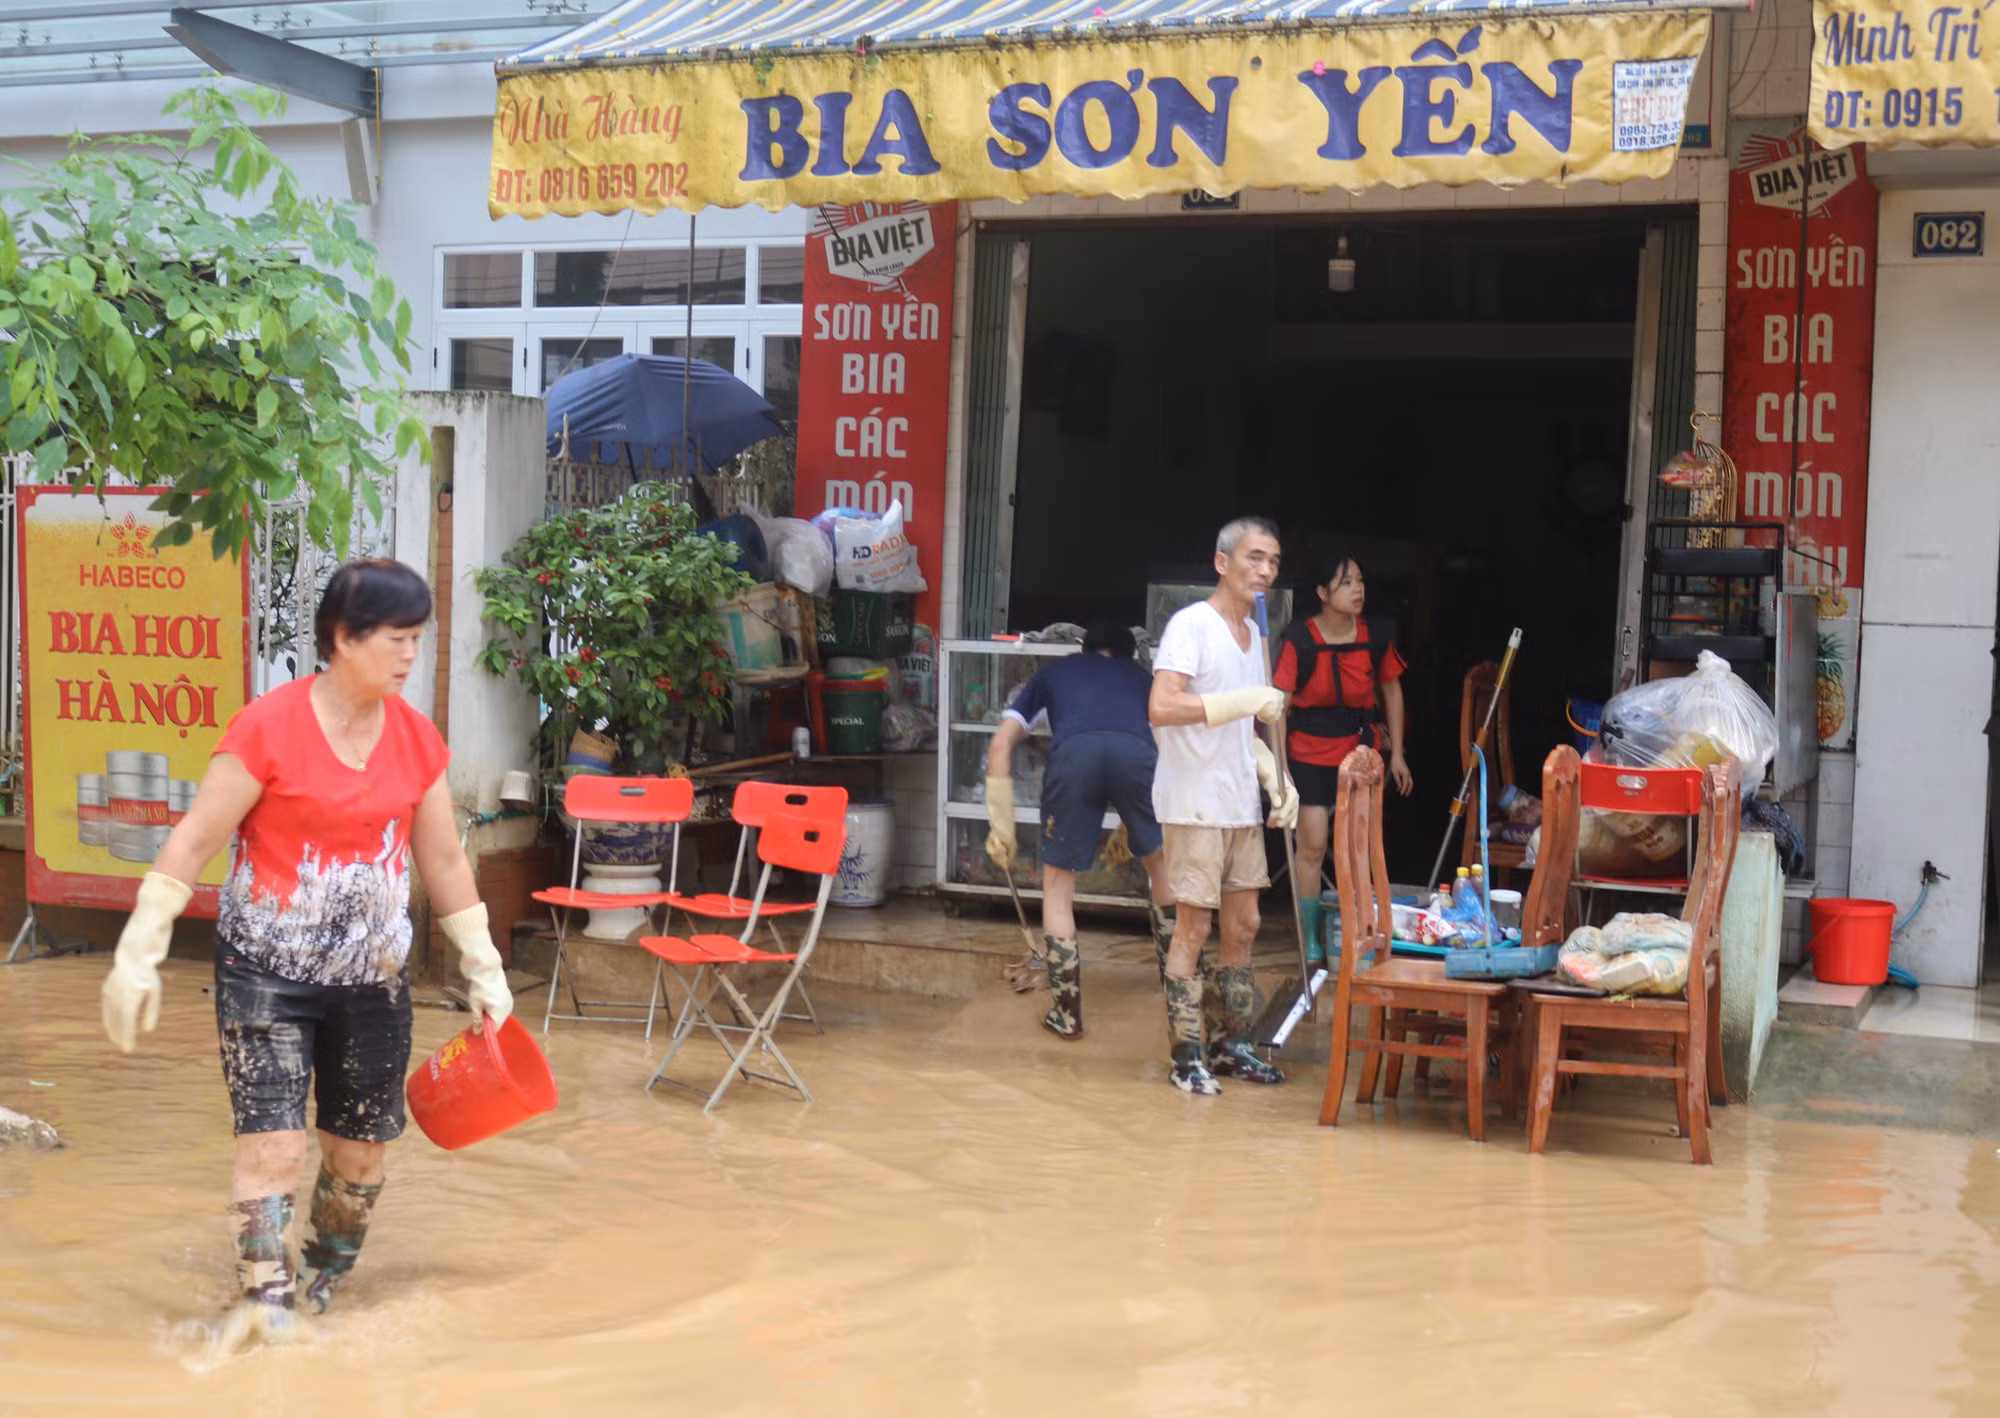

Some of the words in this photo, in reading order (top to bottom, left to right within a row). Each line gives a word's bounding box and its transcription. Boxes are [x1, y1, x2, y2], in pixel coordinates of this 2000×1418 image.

[1823, 10, 1915, 67] Minh
[500, 95, 569, 146] Nhà
[579, 90, 684, 145] Hàng
[738, 89, 943, 181] BIA
[986, 68, 1239, 170] SƠN
[1297, 25, 1584, 160] YẾN
[1825, 90, 1872, 129] ĐT:
[1883, 87, 1963, 128] 0915
[496, 169, 532, 204] ĐT:
[539, 166, 590, 204] 0816
[596, 163, 637, 200] 659
[644, 161, 689, 198] 202
[1755, 166, 1798, 198] BIA
[1797, 152, 1847, 187] VIỆT
[831, 232, 875, 268] BIA
[873, 216, 925, 256] VIỆT
[1921, 220, 1977, 249] 082
[1736, 245, 1796, 289] SƠN
[1806, 232, 1866, 288] YẾN
[814, 301, 872, 341] SƠN
[842, 352, 906, 394] BIA
[835, 407, 909, 458] CÁC
[1756, 380, 1837, 443] CÁC
[825, 471, 914, 522] MÓN
[1744, 461, 1842, 518] MÓN
[79, 564, 186, 589] HABECO
[48, 611, 128, 656] BIA
[131, 614, 222, 660] HƠI
[55, 668, 127, 724] HÀ
[129, 673, 219, 738] NỘI
